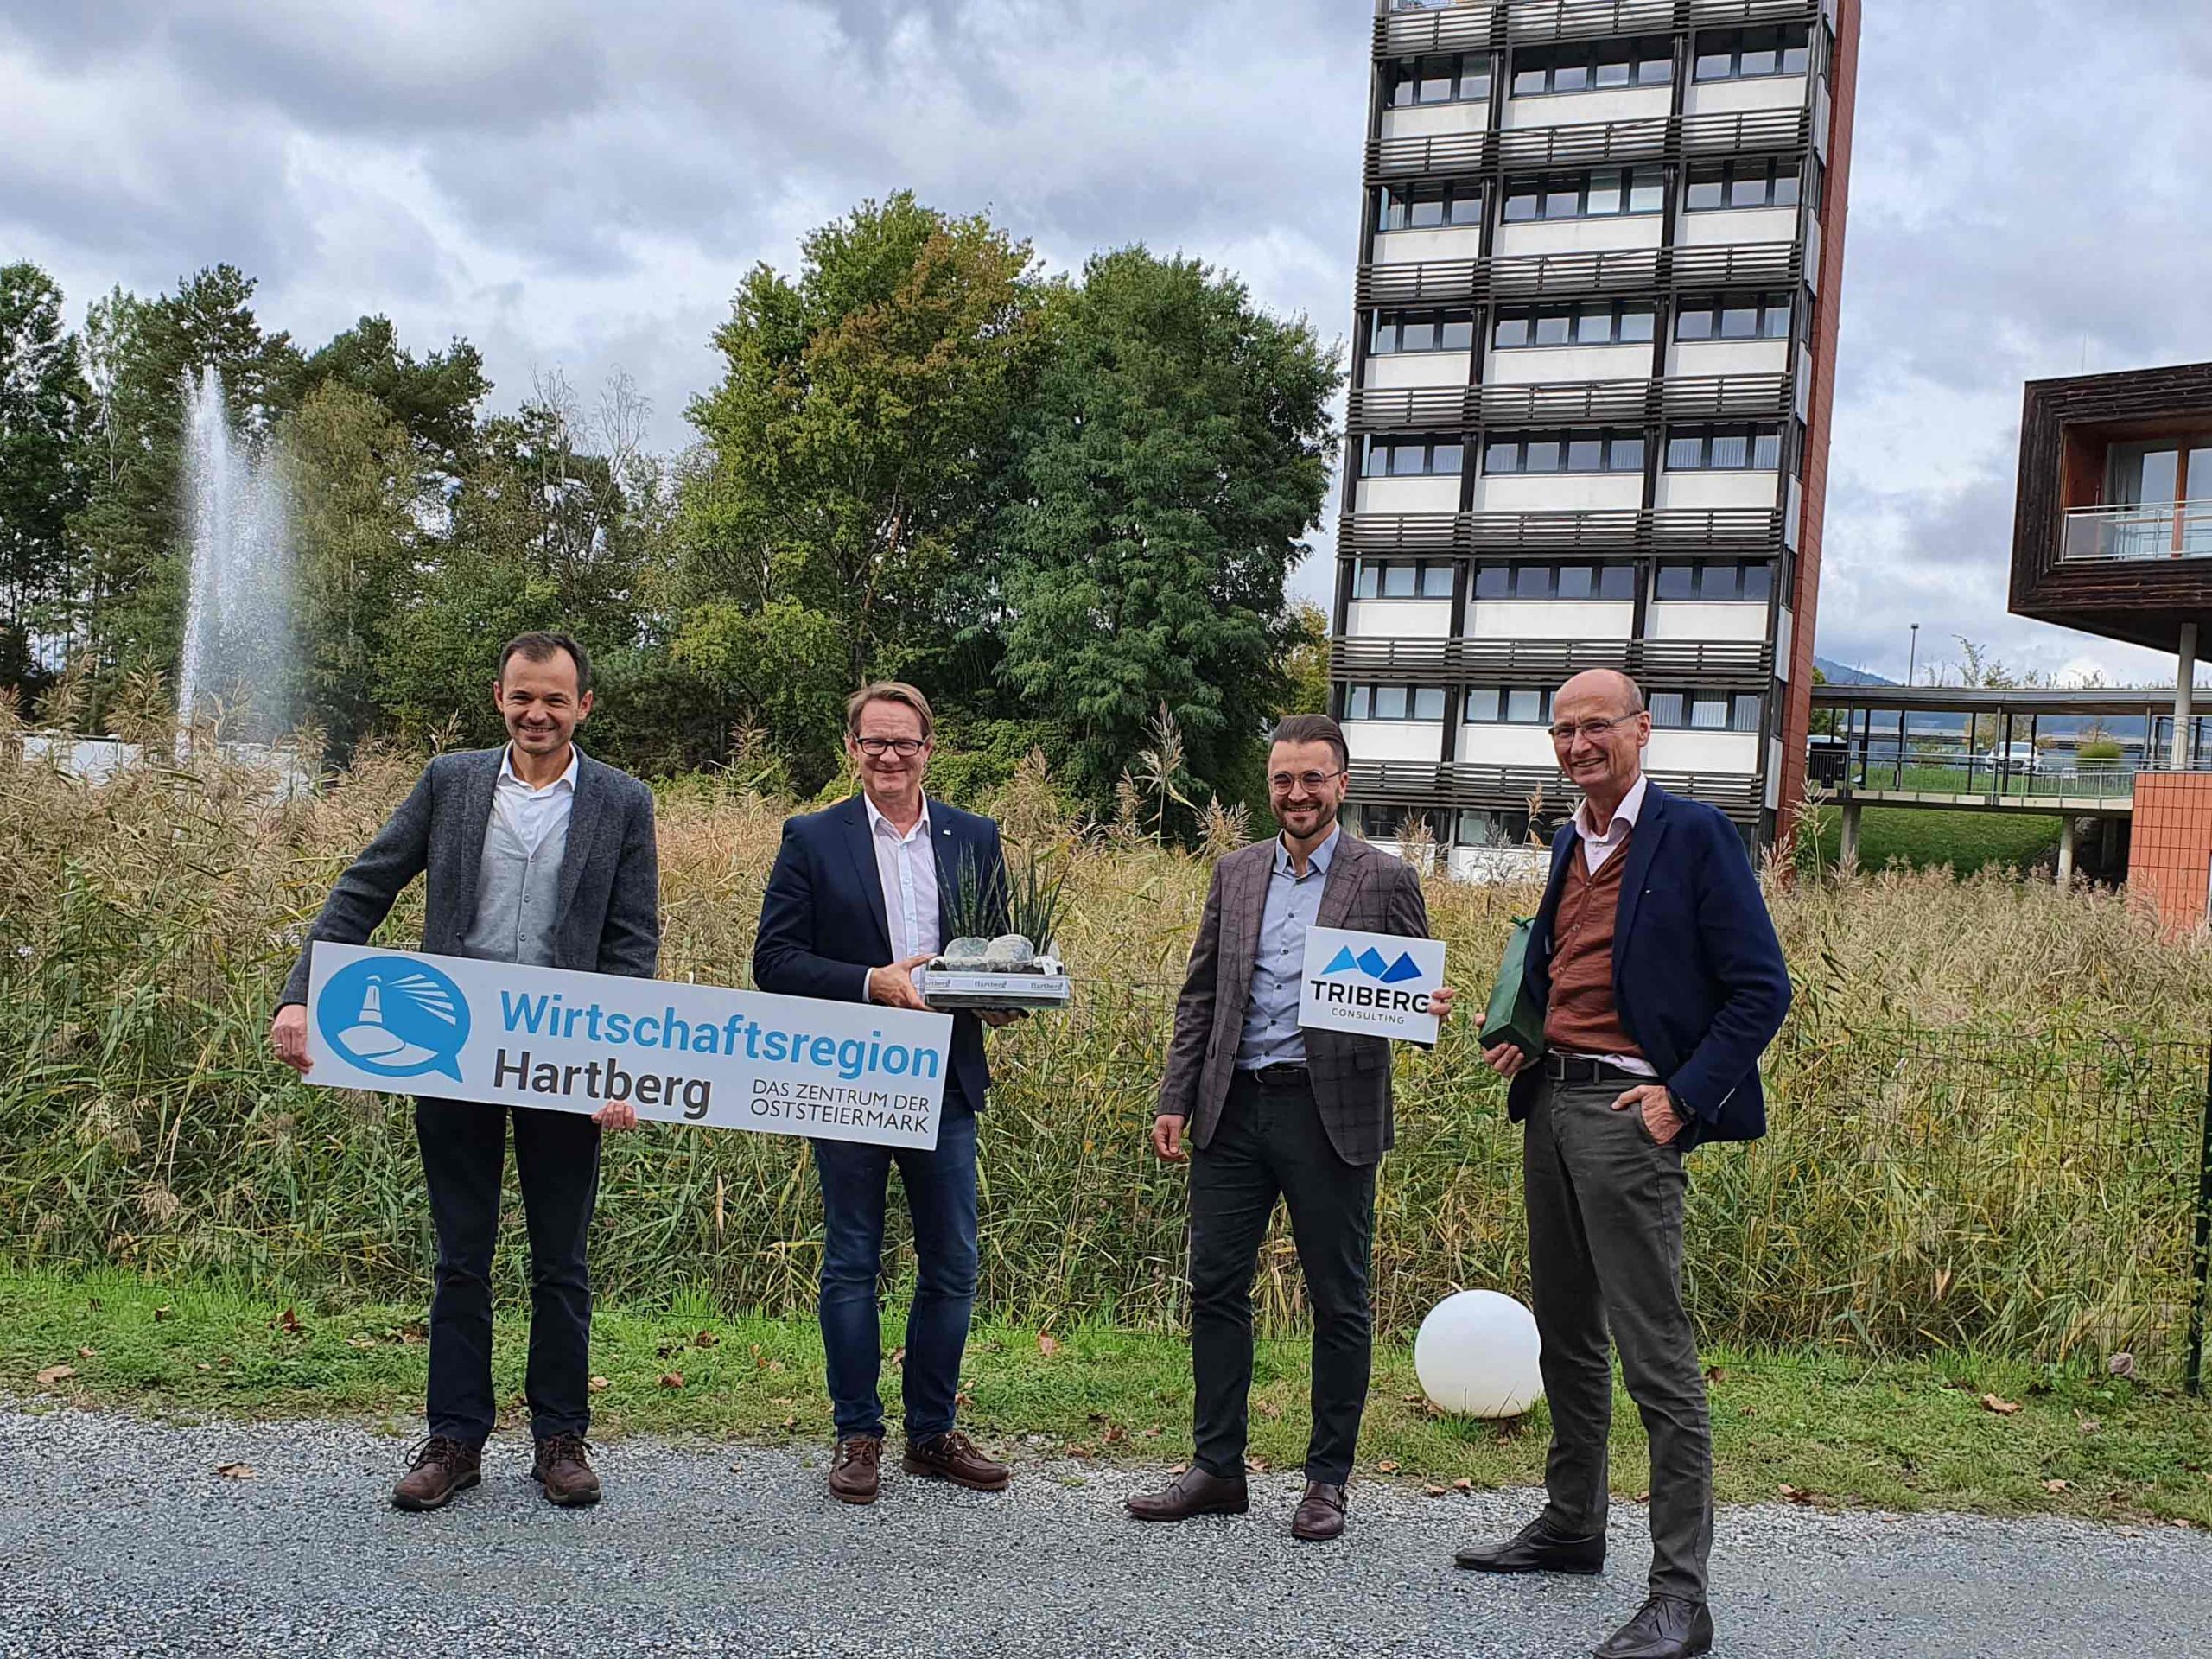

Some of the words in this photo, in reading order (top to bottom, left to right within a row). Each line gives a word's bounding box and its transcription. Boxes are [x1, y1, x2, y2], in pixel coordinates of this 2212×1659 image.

[1310, 980, 1430, 1014] TRIBERG
[1332, 1007, 1404, 1025] CONSULTING
[500, 990, 939, 1079] Wirtschaftsregion
[493, 1048, 712, 1120] Hartberg
[753, 1079, 790, 1097] DAS
[796, 1084, 888, 1109] ZENTRUM
[893, 1094, 931, 1113] DER
[750, 1098, 929, 1134] OSTSTEIERMARK
